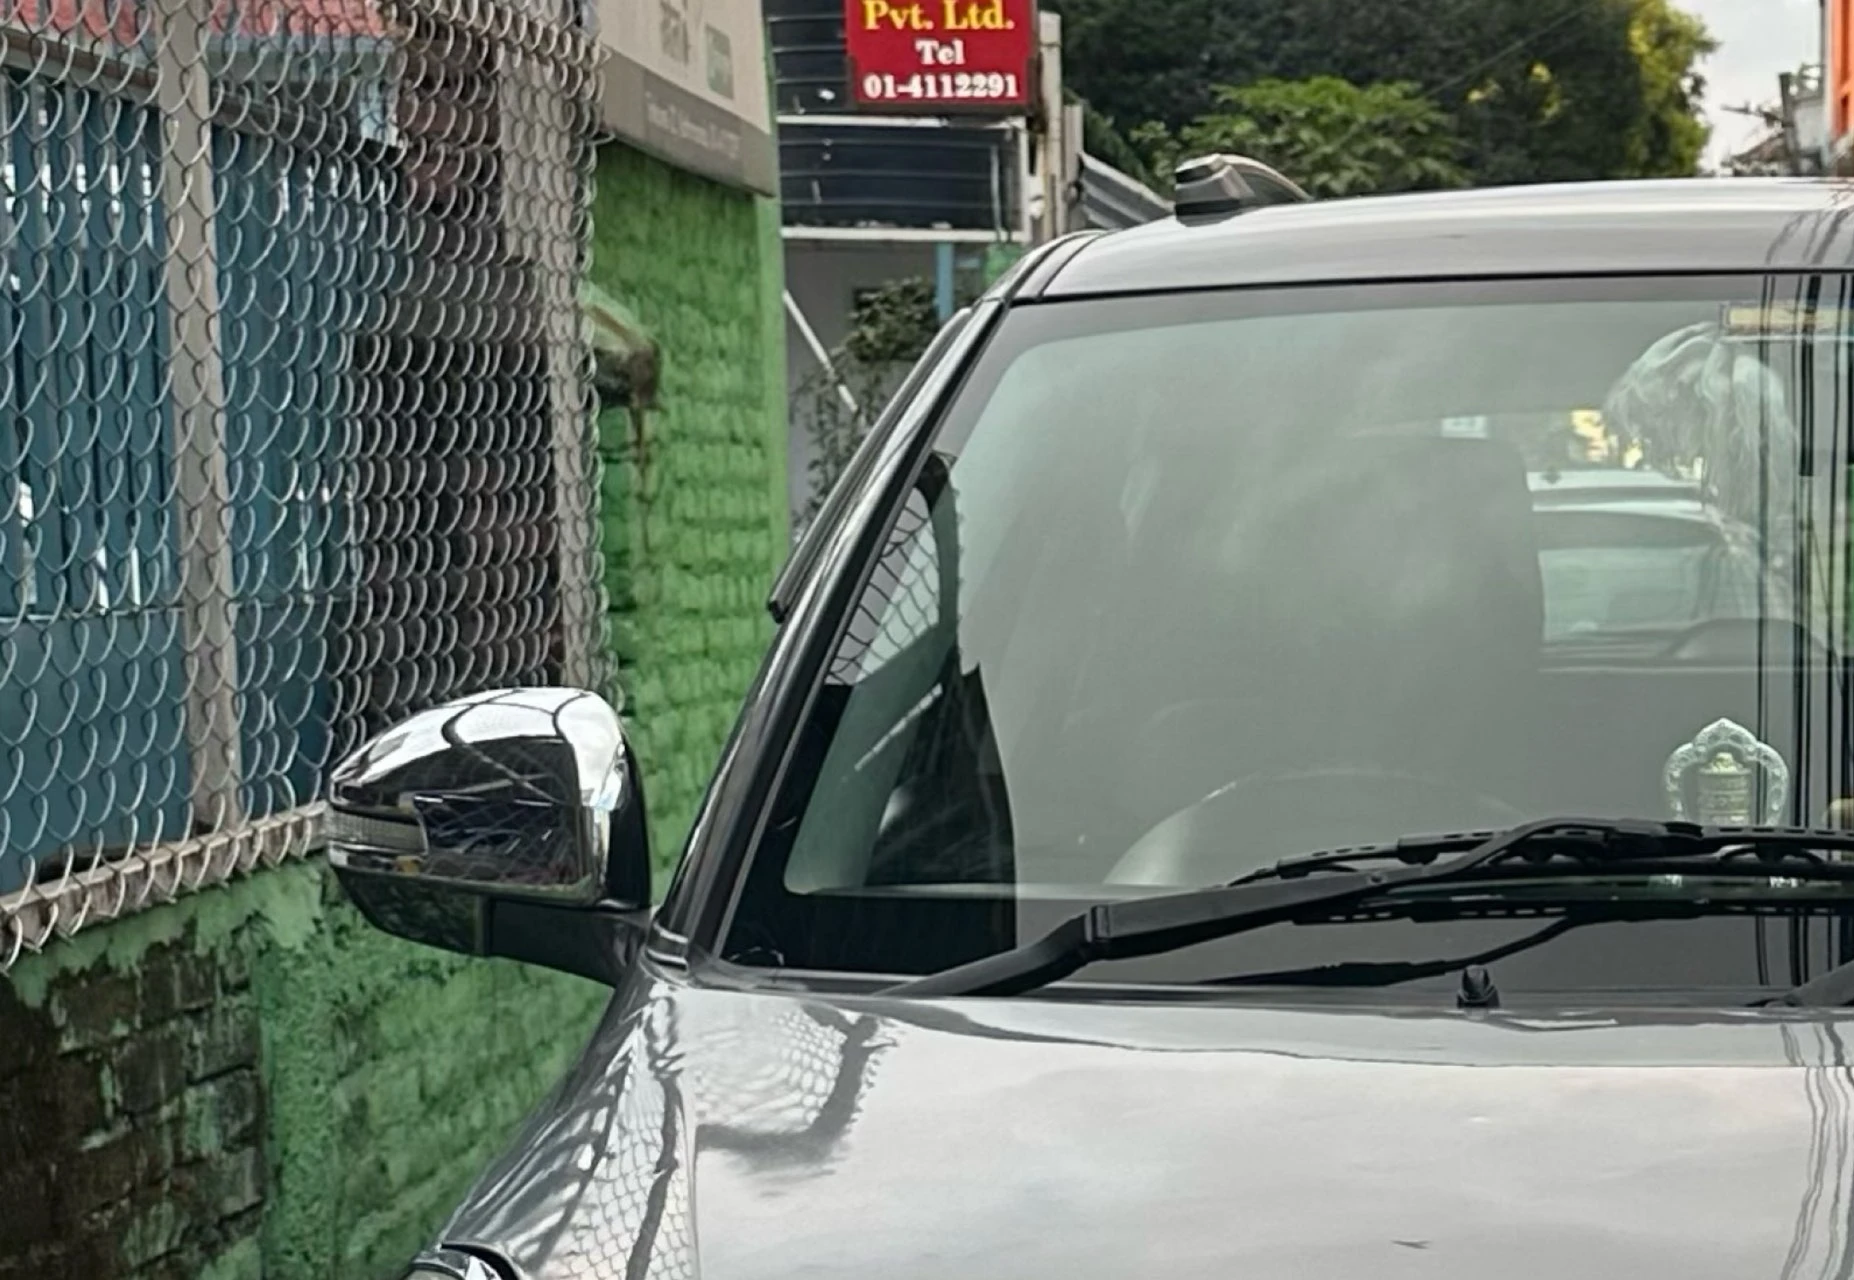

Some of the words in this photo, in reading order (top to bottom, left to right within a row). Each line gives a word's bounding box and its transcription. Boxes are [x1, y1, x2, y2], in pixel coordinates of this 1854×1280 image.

[863, 0, 934, 30] Pvt.
[944, 0, 1015, 30] Ltd.
[915, 39, 965, 65] Tel
[863, 73, 1018, 99] 01-4112291
